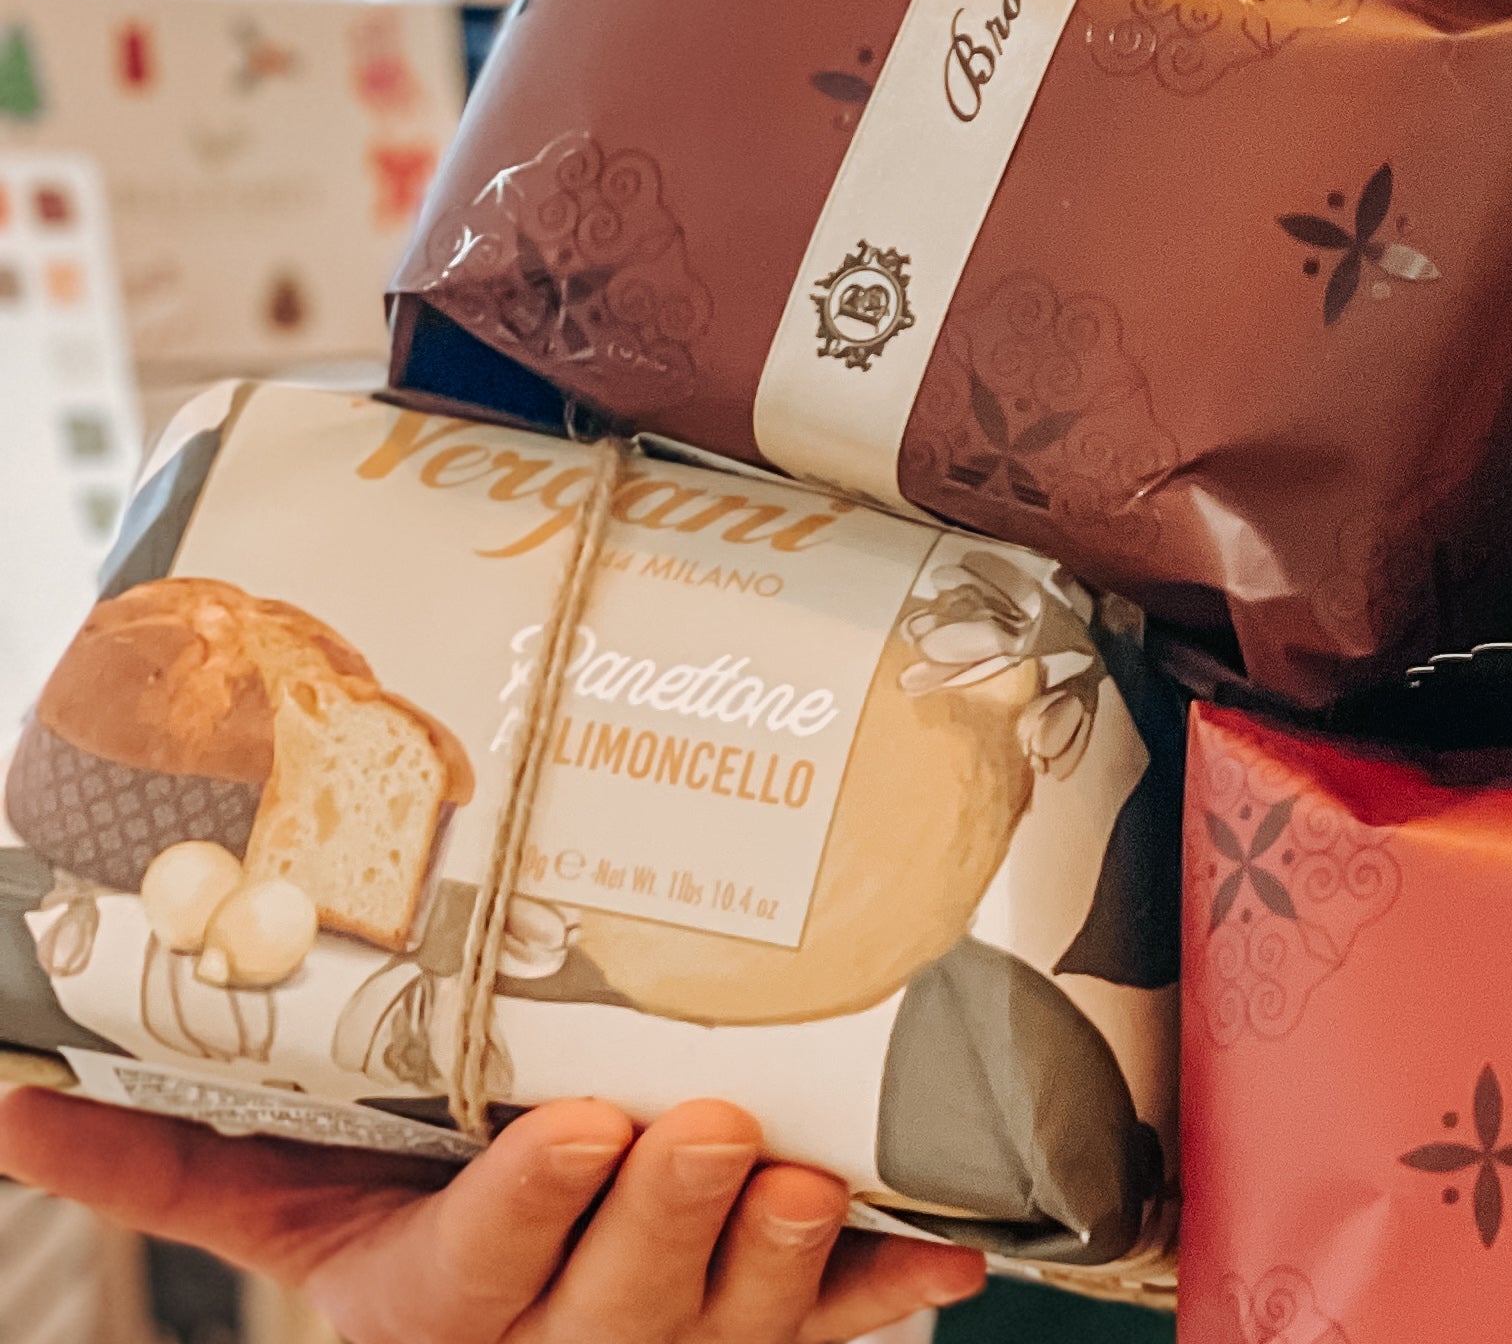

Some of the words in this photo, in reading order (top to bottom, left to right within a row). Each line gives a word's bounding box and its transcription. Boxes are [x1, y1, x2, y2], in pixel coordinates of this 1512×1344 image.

[640, 555, 784, 598] MILANO
[552, 716, 816, 810] LIMONCELLO
[756, 897, 780, 921] oz
